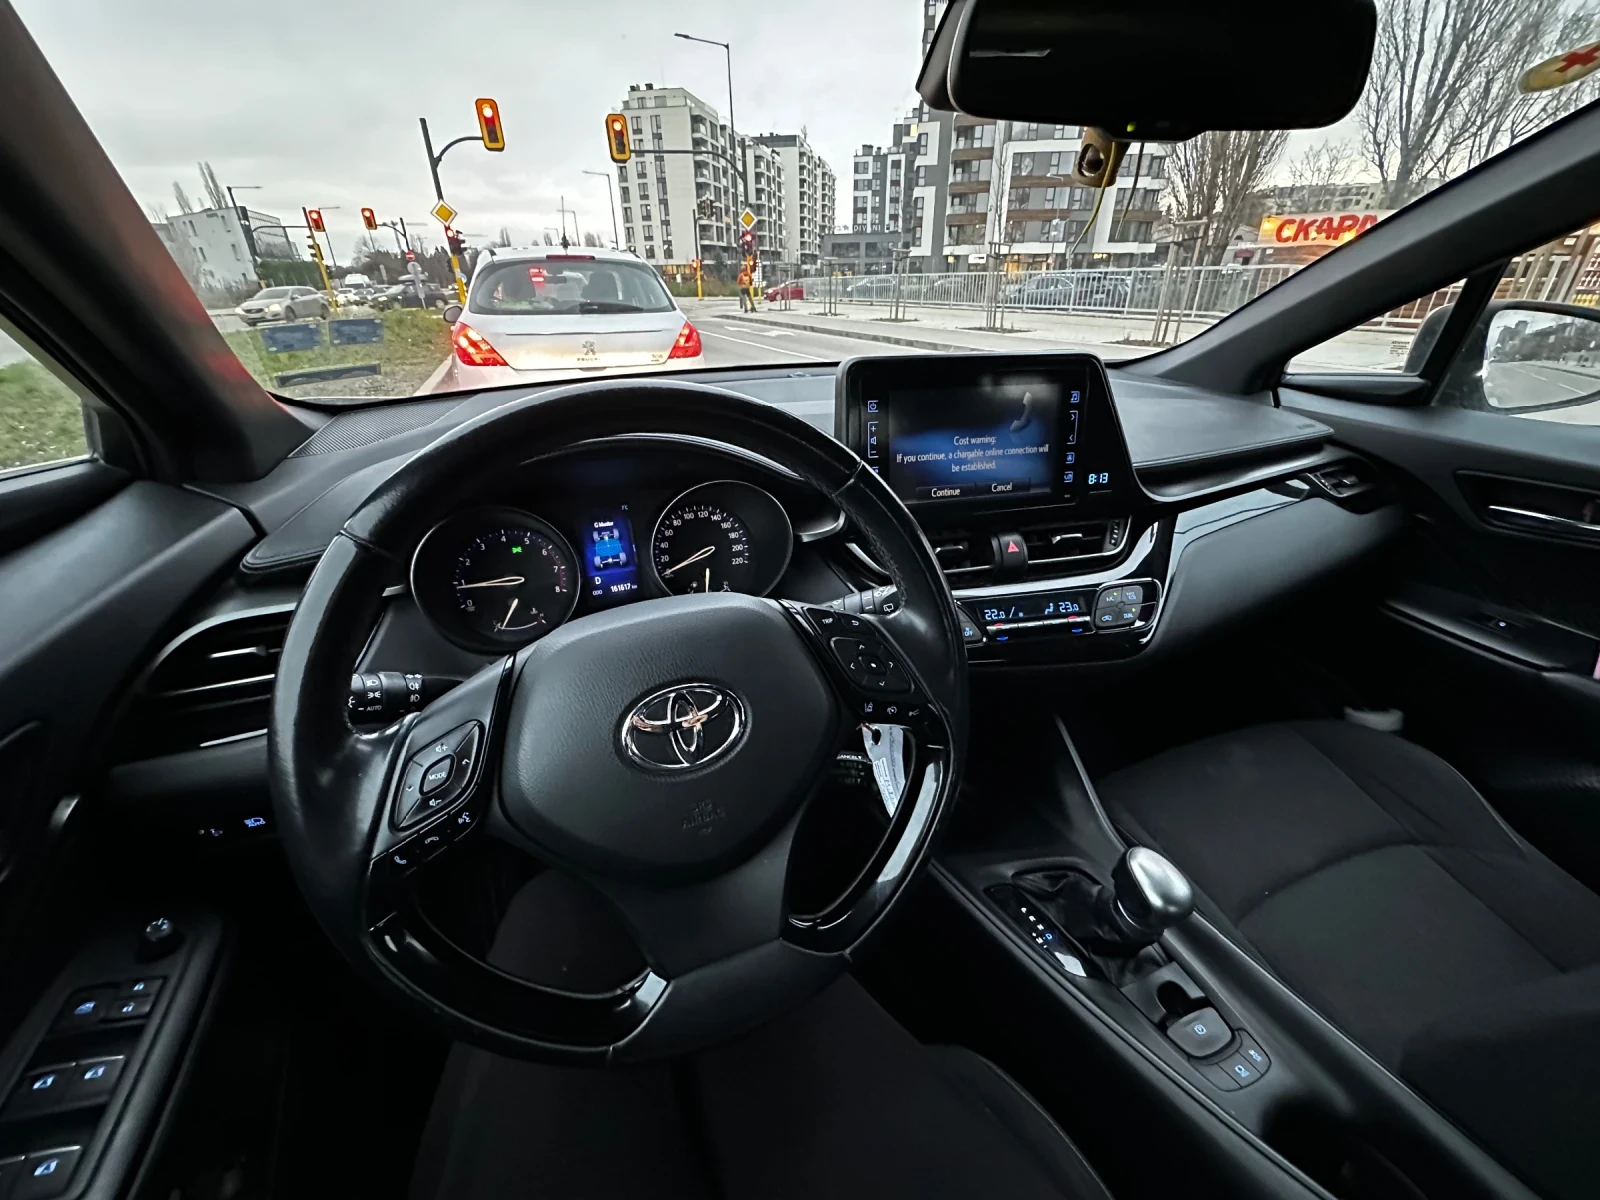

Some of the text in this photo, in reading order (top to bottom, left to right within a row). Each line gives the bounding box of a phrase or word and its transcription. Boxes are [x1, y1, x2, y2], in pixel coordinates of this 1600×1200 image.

[853, 224, 881, 232] DIVNI
[953, 435, 997, 447] Cost warning:
[896, 453, 903, 463] If
[903, 454, 916, 465] you
[917, 452, 947, 462] continue,
[953, 449, 984, 460] chargable
[985, 447, 1003, 457] online
[1004, 445, 1037, 455] connection
[1038, 444, 1050, 453] will
[951, 461, 997, 473] be established.
[1088, 472, 1109, 485] 8:13
[991, 482, 1013, 493] Cancel
[931, 487, 960, 498] Continue
[683, 512, 695, 520] 100
[697, 510, 709, 518] 120
[672, 518, 682, 526] 80
[720, 521, 732, 529] 160
[664, 529, 674, 537] 60
[728, 531, 740, 539] 180
[500, 535, 507, 543] 4
[523, 537, 530, 545] 5
[480, 543, 486, 551] 3
[660, 541, 669, 549] 40
[731, 543, 744, 552] 200
[541, 548, 548, 556] 6
[465, 558, 471, 566] 2
[660, 554, 670, 562] 20
[731, 557, 744, 565] 220
[553, 565, 559, 573] 7
[594, 576, 601, 585] D
[555, 585, 561, 593] 8
[610, 582, 631, 593] 161617
[1058, 601, 1080, 613] 23.0
[984, 608, 1006, 621] 22.0
[821, 617, 834, 625] TRIP
[366, 704, 382, 712] AUTO
[428, 771, 447, 781] MODE
[1044, 932, 1053, 940] D
